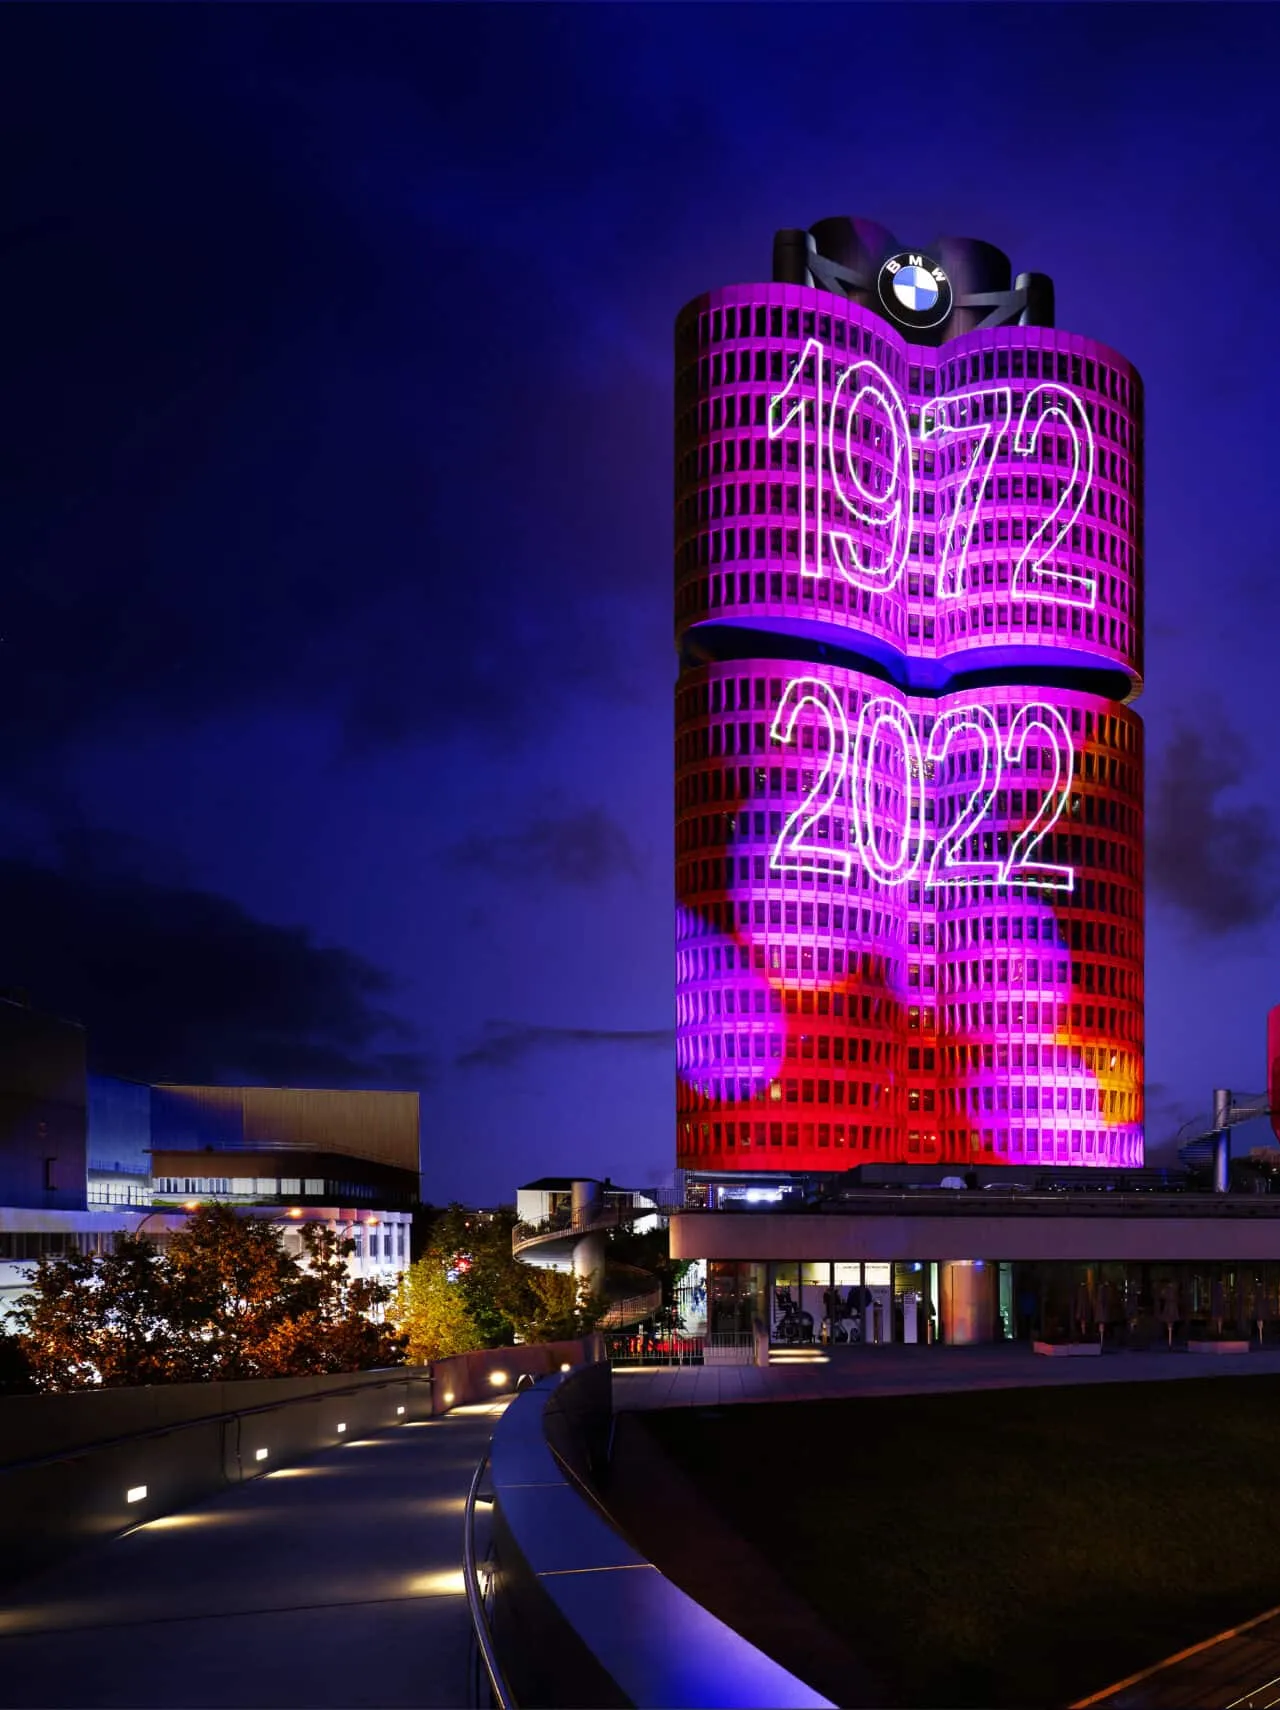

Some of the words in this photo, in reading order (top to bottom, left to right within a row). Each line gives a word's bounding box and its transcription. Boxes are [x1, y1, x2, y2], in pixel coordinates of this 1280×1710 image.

[887, 255, 946, 281] BMW
[768, 338, 1096, 608] 1972
[770, 677, 1074, 890] 2022
